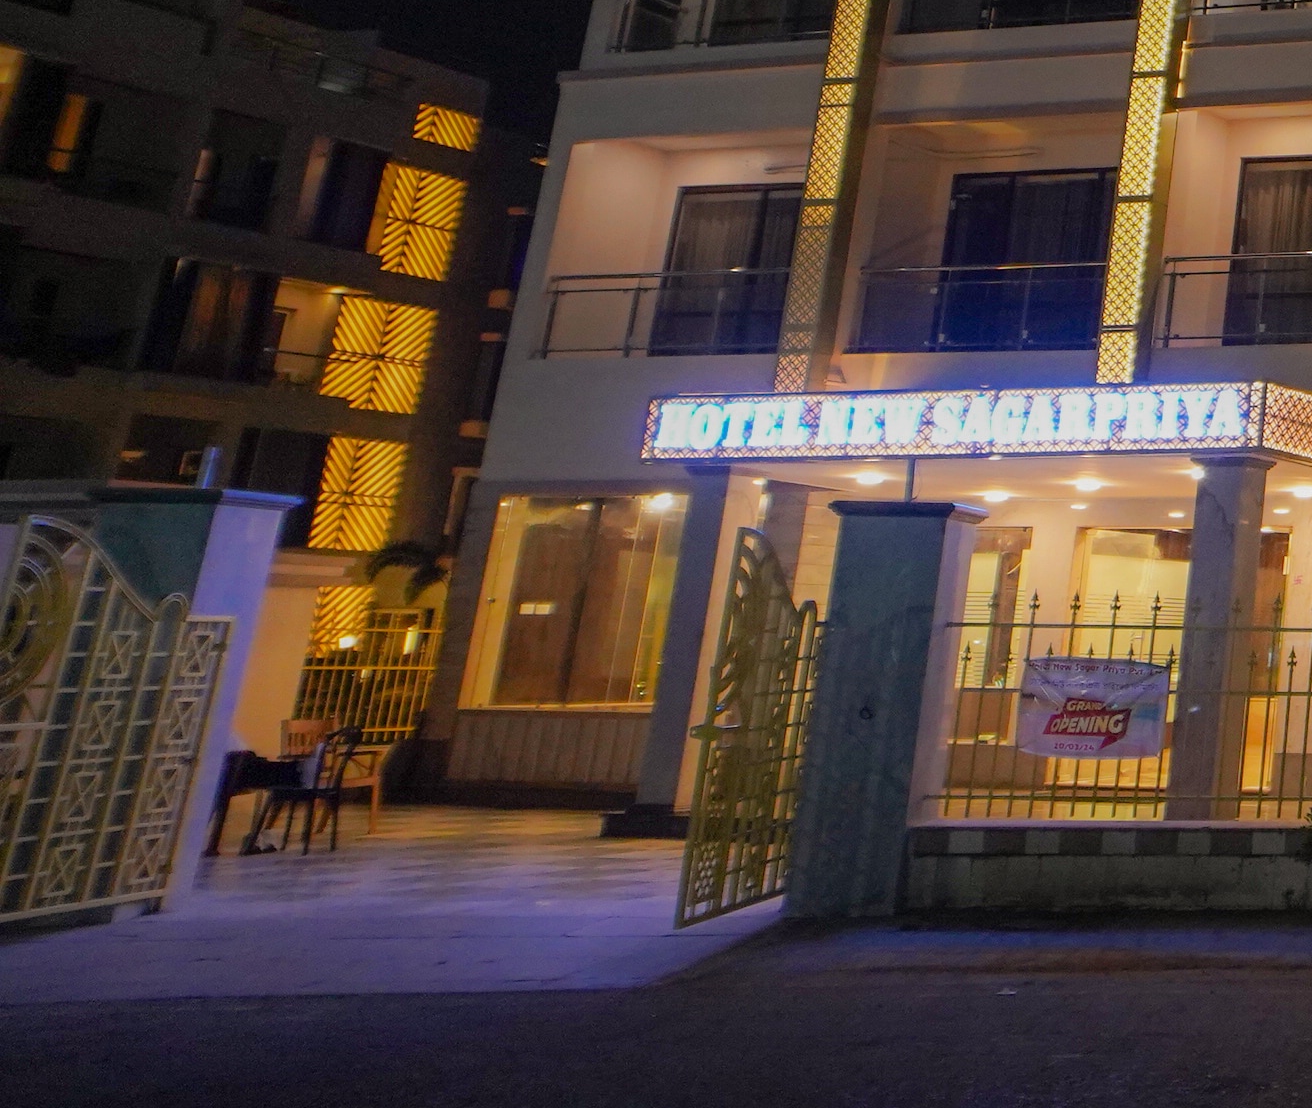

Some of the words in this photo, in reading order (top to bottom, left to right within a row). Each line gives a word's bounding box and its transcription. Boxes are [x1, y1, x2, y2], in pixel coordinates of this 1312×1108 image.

[653, 400, 808, 449] HOTEL
[814, 397, 926, 446] NEW
[931, 390, 1245, 446] SAGARPRIYA
[1053, 663, 1072, 671] New
[1075, 663, 1099, 673] Sagar
[1050, 713, 1125, 734] OPENING
